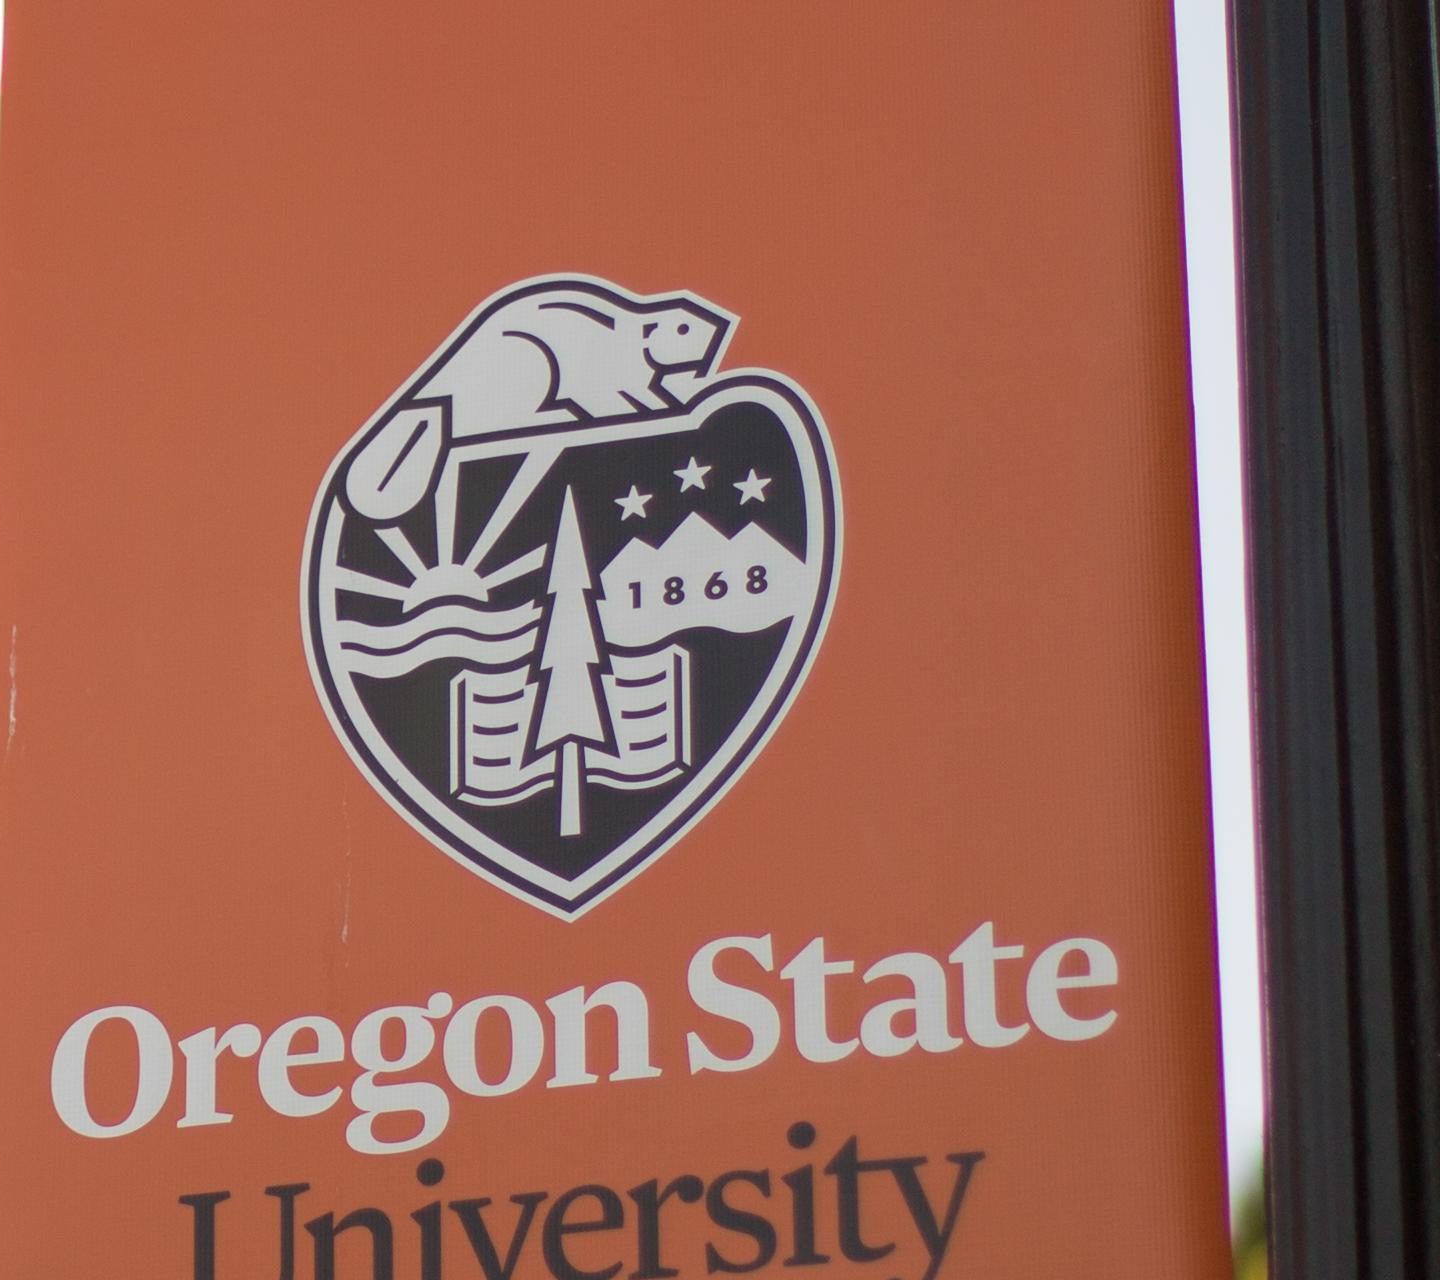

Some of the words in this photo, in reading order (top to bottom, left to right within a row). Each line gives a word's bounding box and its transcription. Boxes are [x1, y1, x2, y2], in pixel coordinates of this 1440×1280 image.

[628, 565, 769, 610] 1868
[50, 991, 663, 1155] Oregon
[686, 921, 1119, 1075] State
